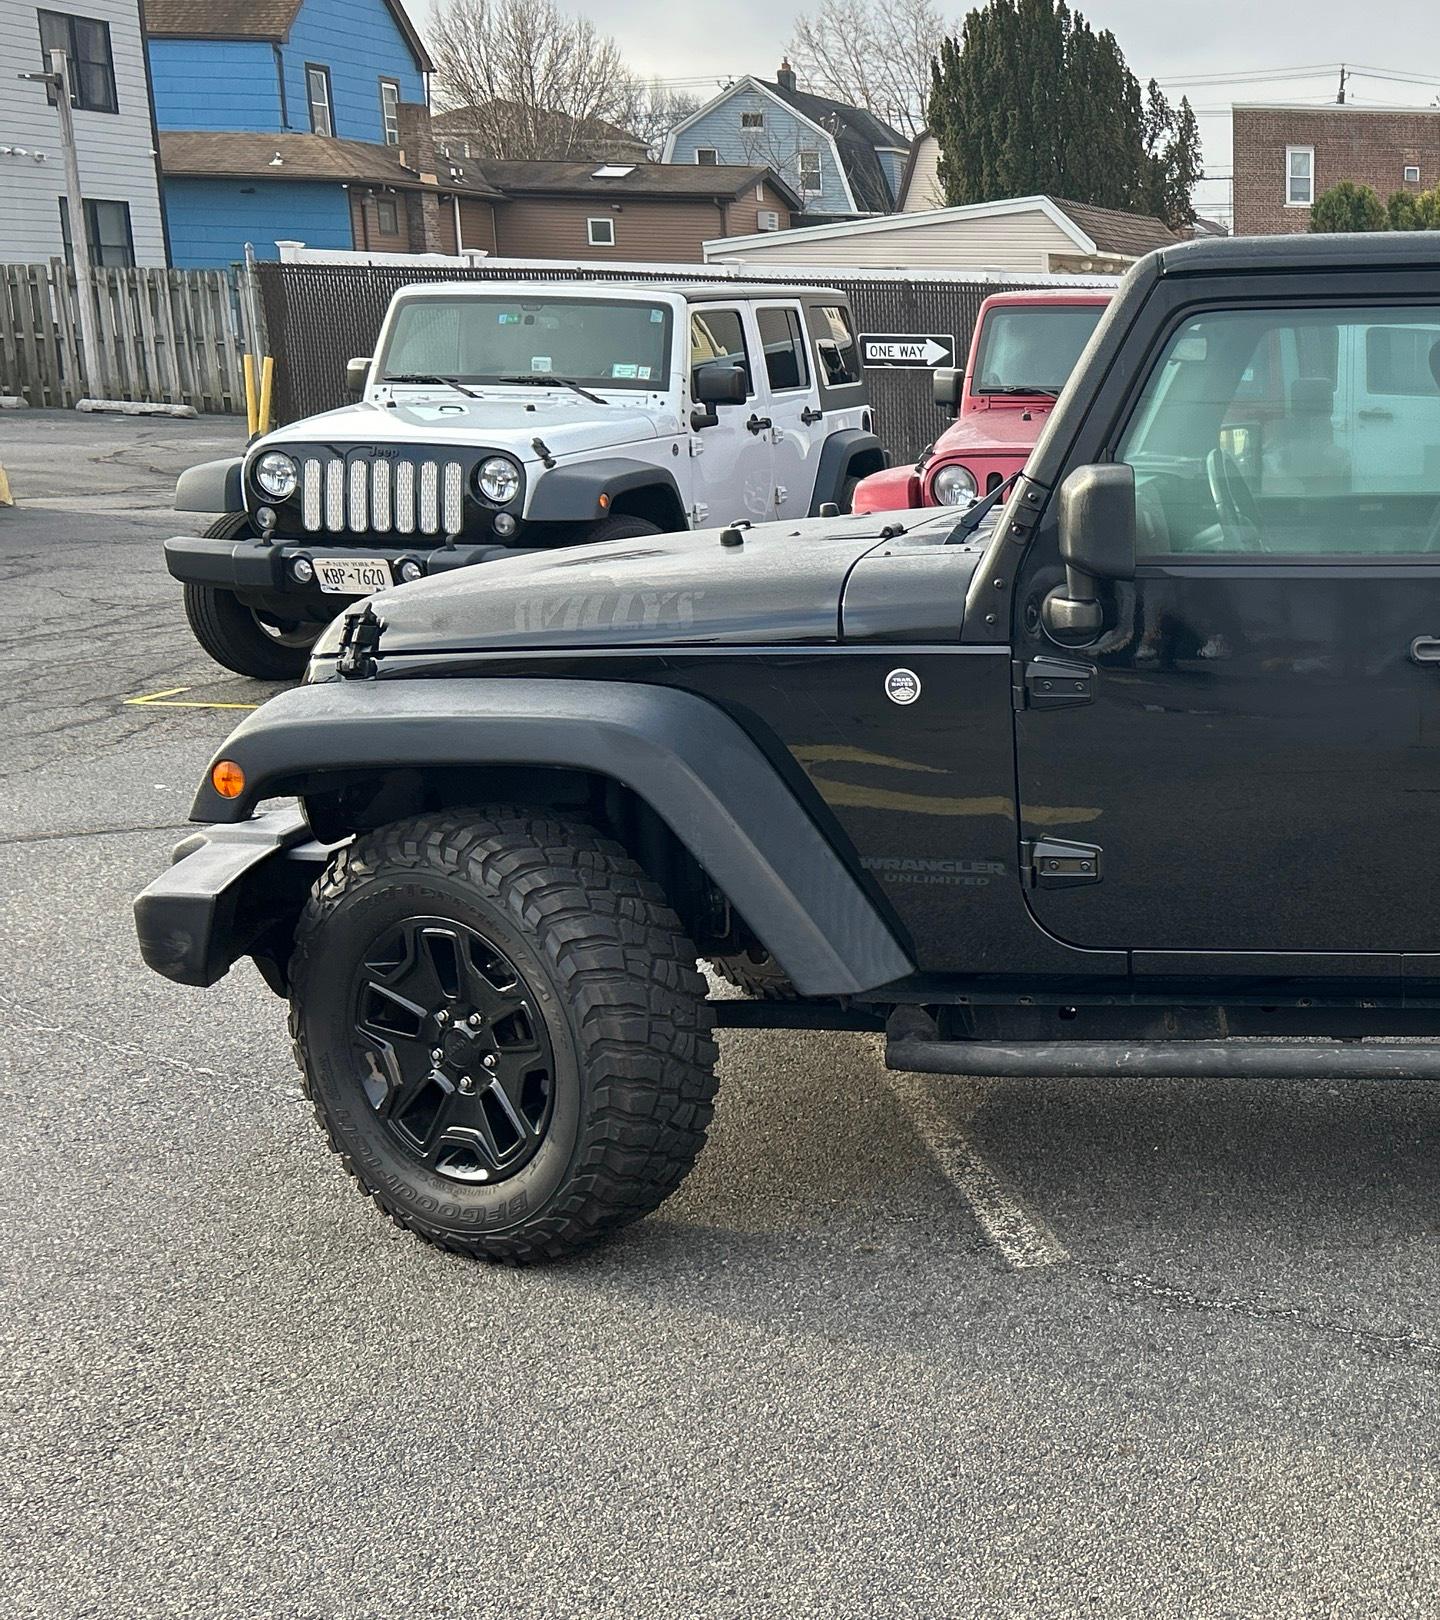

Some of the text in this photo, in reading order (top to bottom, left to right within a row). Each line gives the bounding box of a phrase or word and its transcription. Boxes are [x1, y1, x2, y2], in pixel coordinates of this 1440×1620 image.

[870, 345, 925, 358] ONE WAY
[368, 446, 400, 459] Jeep
[322, 568, 385, 585] KBP 7620
[514, 591, 705, 631] WILLYS
[859, 857, 1008, 876] WRANGLER
[884, 873, 991, 886] UNLIMITED
